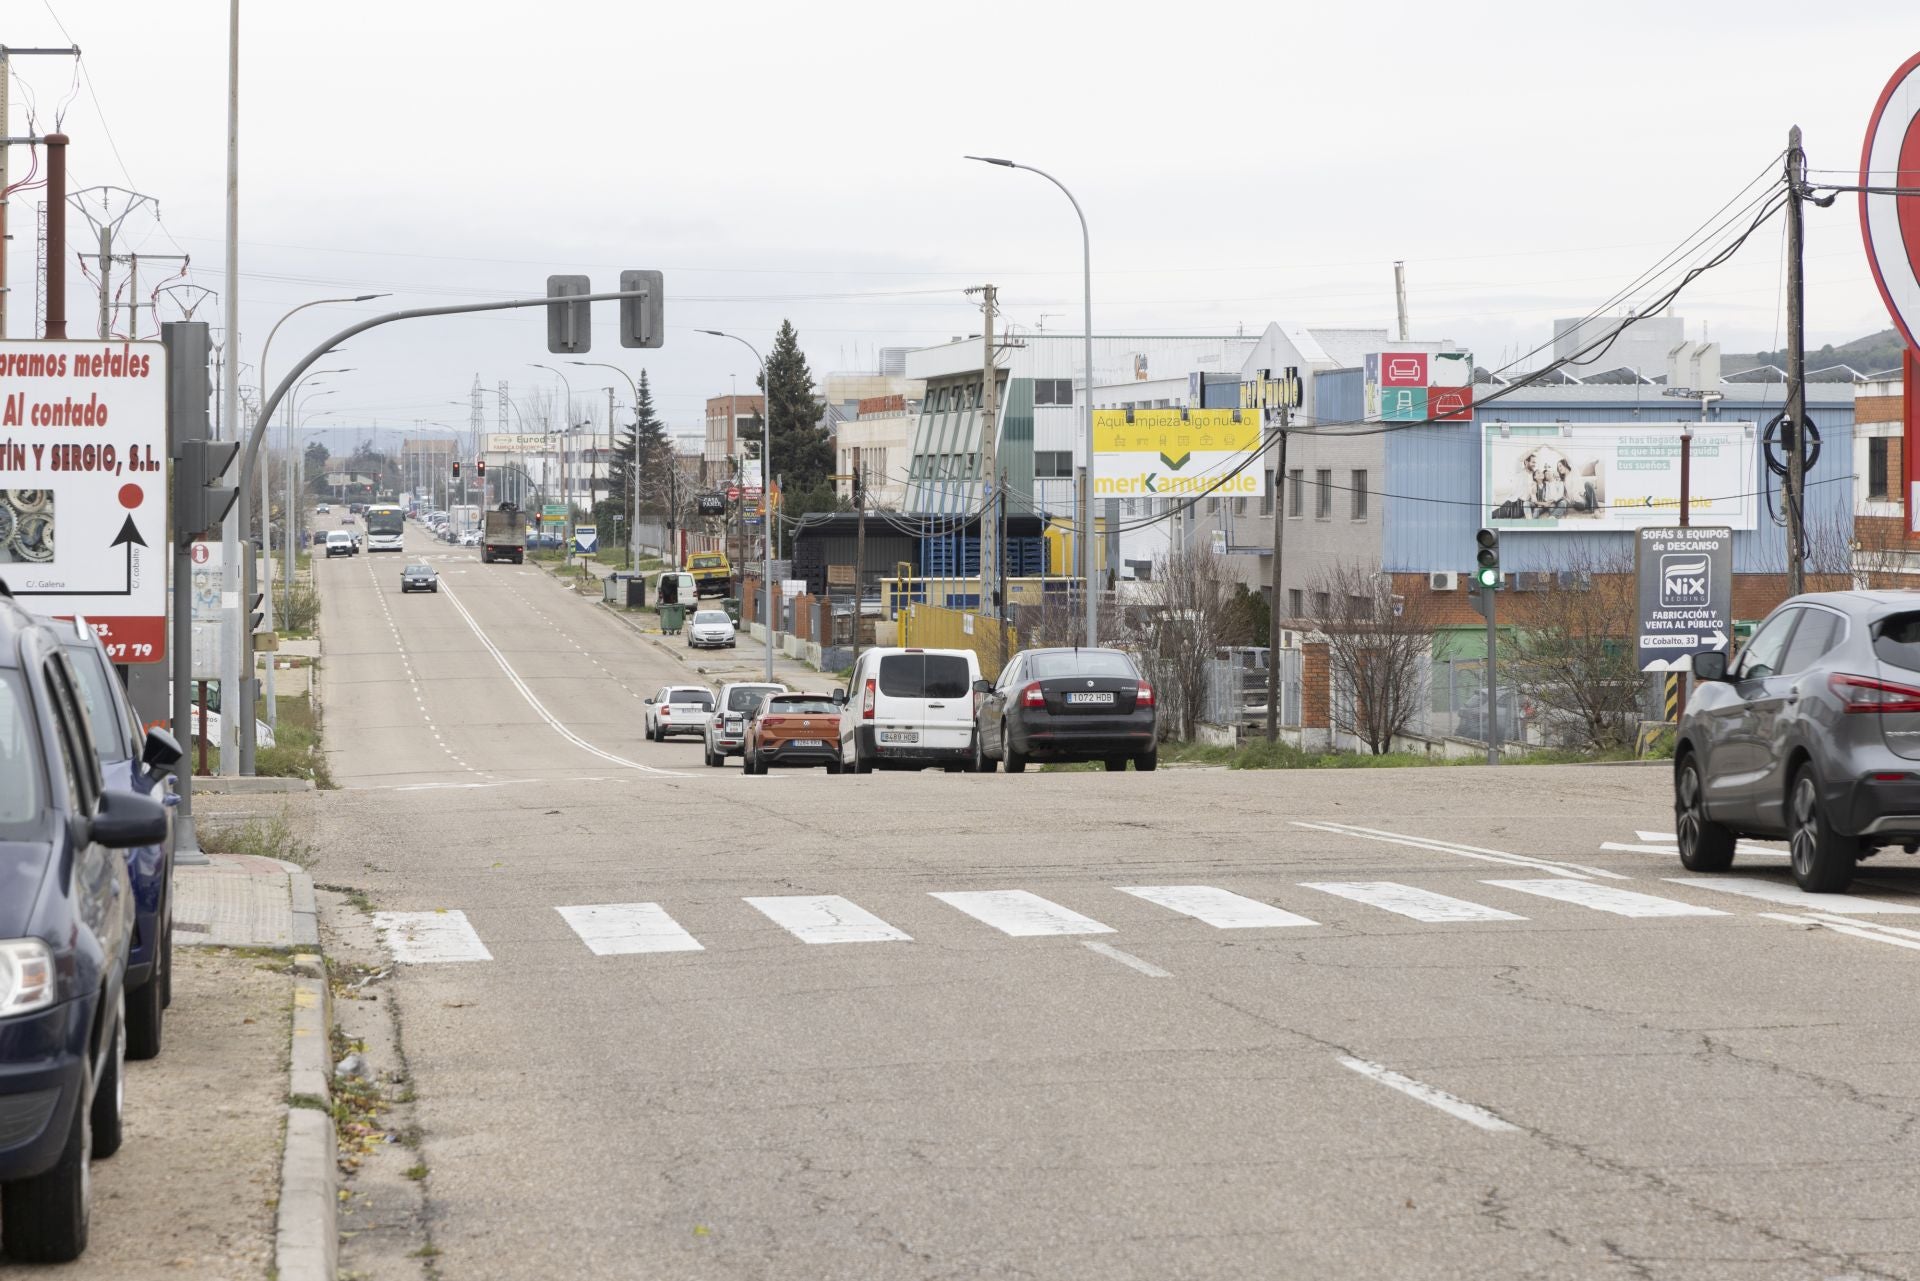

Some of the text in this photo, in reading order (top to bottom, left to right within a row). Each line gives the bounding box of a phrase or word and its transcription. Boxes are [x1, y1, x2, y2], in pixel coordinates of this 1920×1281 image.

[74, 343, 150, 378] metales
[2, 391, 108, 427] Al contado
[1629, 435, 1645, 445] has
[1631, 447, 1647, 458] que
[1650, 446, 1665, 456] has
[1667, 446, 1718, 458] perguido
[32, 443, 45, 471] Y
[51, 443, 122, 477] SERGIO,
[129, 443, 160, 472] S.L.
[1618, 461, 1633, 470] tus
[1642, 528, 1730, 540] SOFÁS & EQUIPOS
[1652, 541, 1719, 551] de DESCANSO
[132, 548, 140, 577] cobalto
[38, 580, 66, 588] Galena
[1652, 609, 1718, 620] FABRICACIÓN Y
[1645, 618, 1724, 630] VENTA AL PÚBLICO
[1643, 637, 1695, 647] C/ Cobalto, 33
[106, 643, 153, 657] 67 79
[1073, 693, 1112, 702] 1072 HDB
